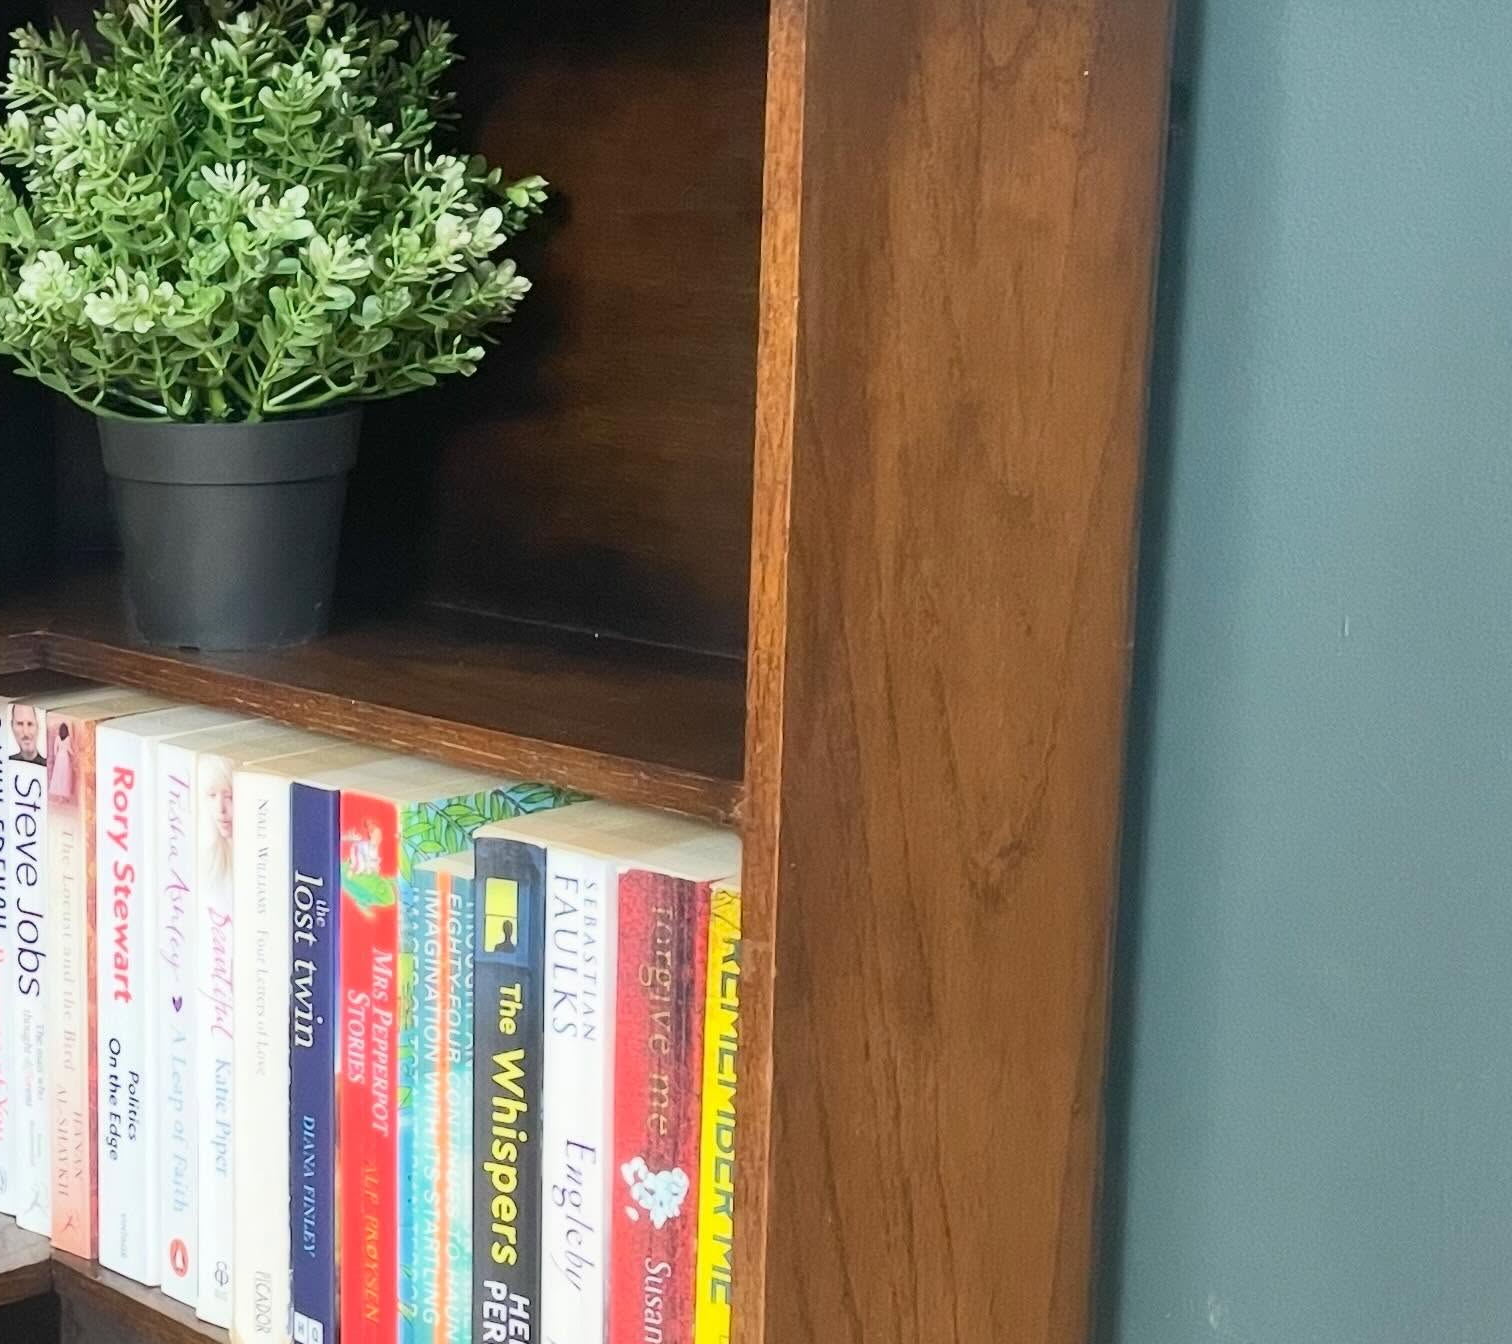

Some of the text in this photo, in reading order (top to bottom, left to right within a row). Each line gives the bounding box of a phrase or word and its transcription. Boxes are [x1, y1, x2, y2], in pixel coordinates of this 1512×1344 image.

[14, 774, 46, 997] Steve Jobs
[107, 766, 136, 1004] Rory Stewart
[160, 774, 191, 974] Trisha Ashley
[315, 899, 330, 929] the
[62, 831, 77, 1072] The Locust and the Bird
[198, 906, 235, 1040] Beautiful
[293, 870, 326, 1050] lost twin
[552, 874, 579, 1042] FAULKS
[583, 879, 598, 1043] SEBASTIAN
[638, 904, 674, 1137] forgive me
[105, 1037, 122, 1163] On the Edge
[127, 1069, 140, 1141] Politics
[168, 1055, 187, 1114] Leap
[172, 1118, 188, 1144] of
[211, 1057, 232, 1178] Katie Piper
[422, 888, 441, 1326] IMAGINATION WITH ITS STARTLING
[483, 982, 528, 1268] The Whispers
[170, 1155, 190, 1213] Faith
[302, 1114, 317, 1258] DIANA FINLEY
[552, 1139, 597, 1293] Engleby
[254, 1270, 272, 1336] PICADOR
